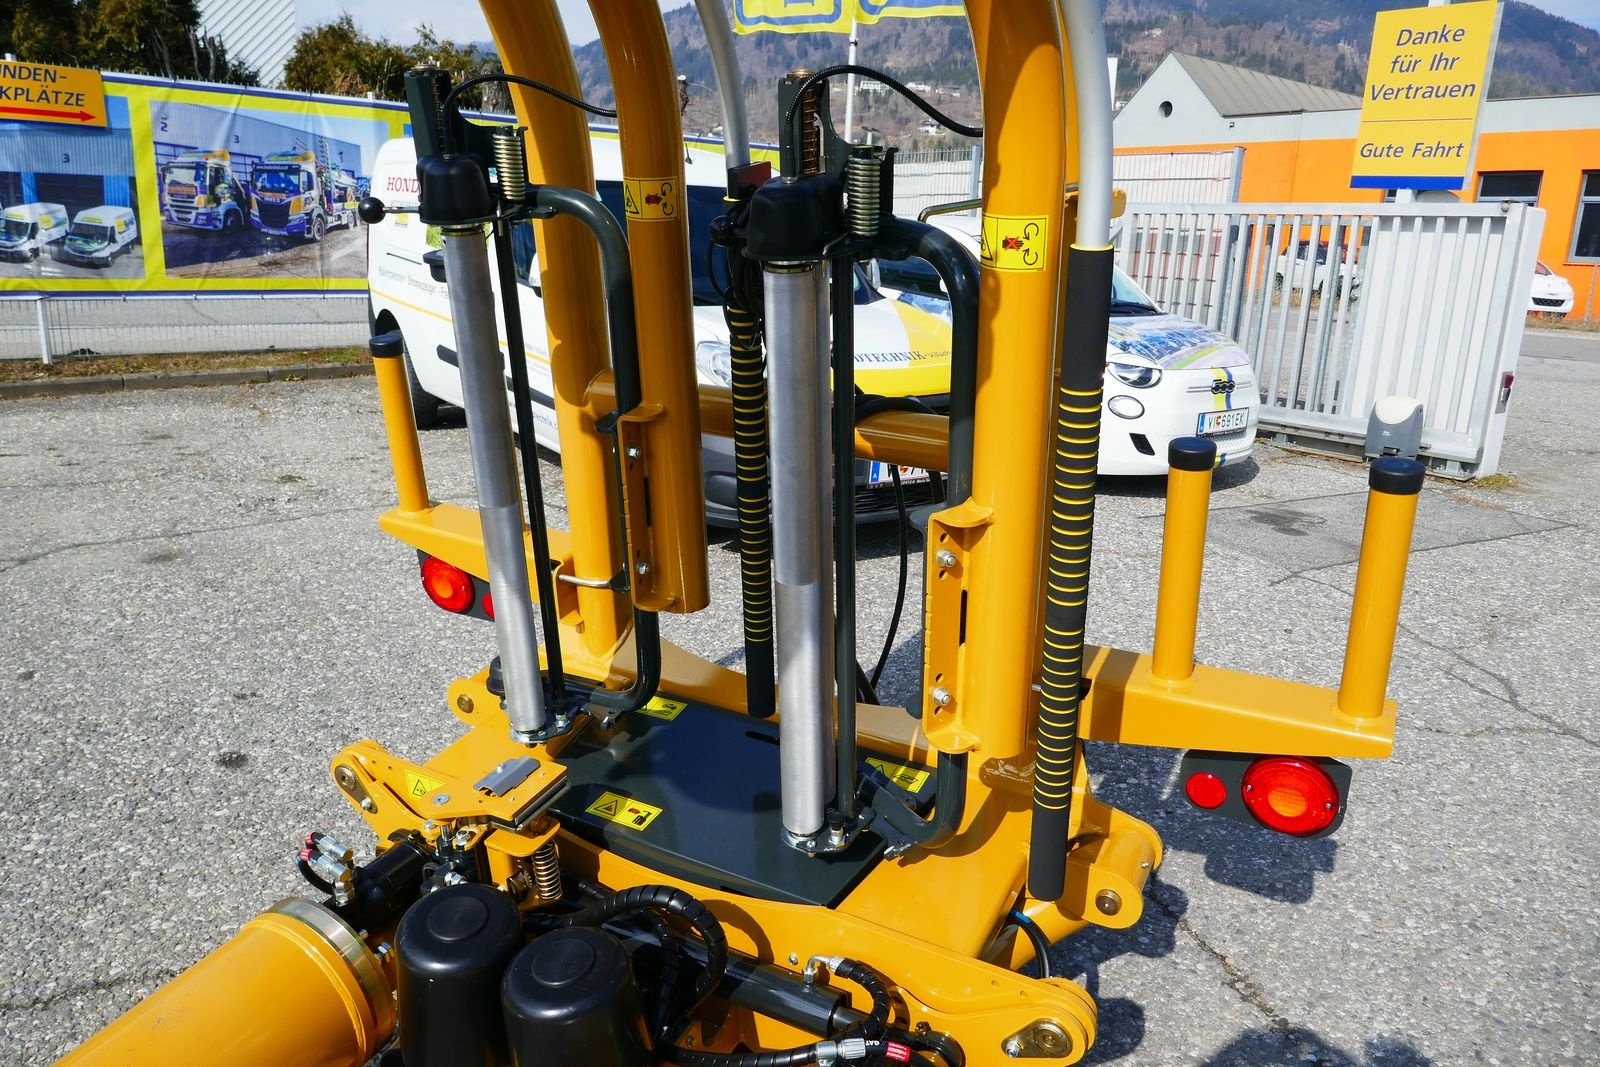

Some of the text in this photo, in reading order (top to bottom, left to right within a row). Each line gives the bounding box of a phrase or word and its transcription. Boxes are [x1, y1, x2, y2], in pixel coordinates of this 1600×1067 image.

[1396, 24, 1465, 47] Danke
[1390, 52, 1461, 74] für Ihr
[0, 63, 67, 83] NDEN-
[1371, 83, 1476, 101] Vertrauen
[233, 134, 240, 144] 3
[63, 153, 70, 163] 3
[1360, 141, 1465, 158] Gute Fahrt
